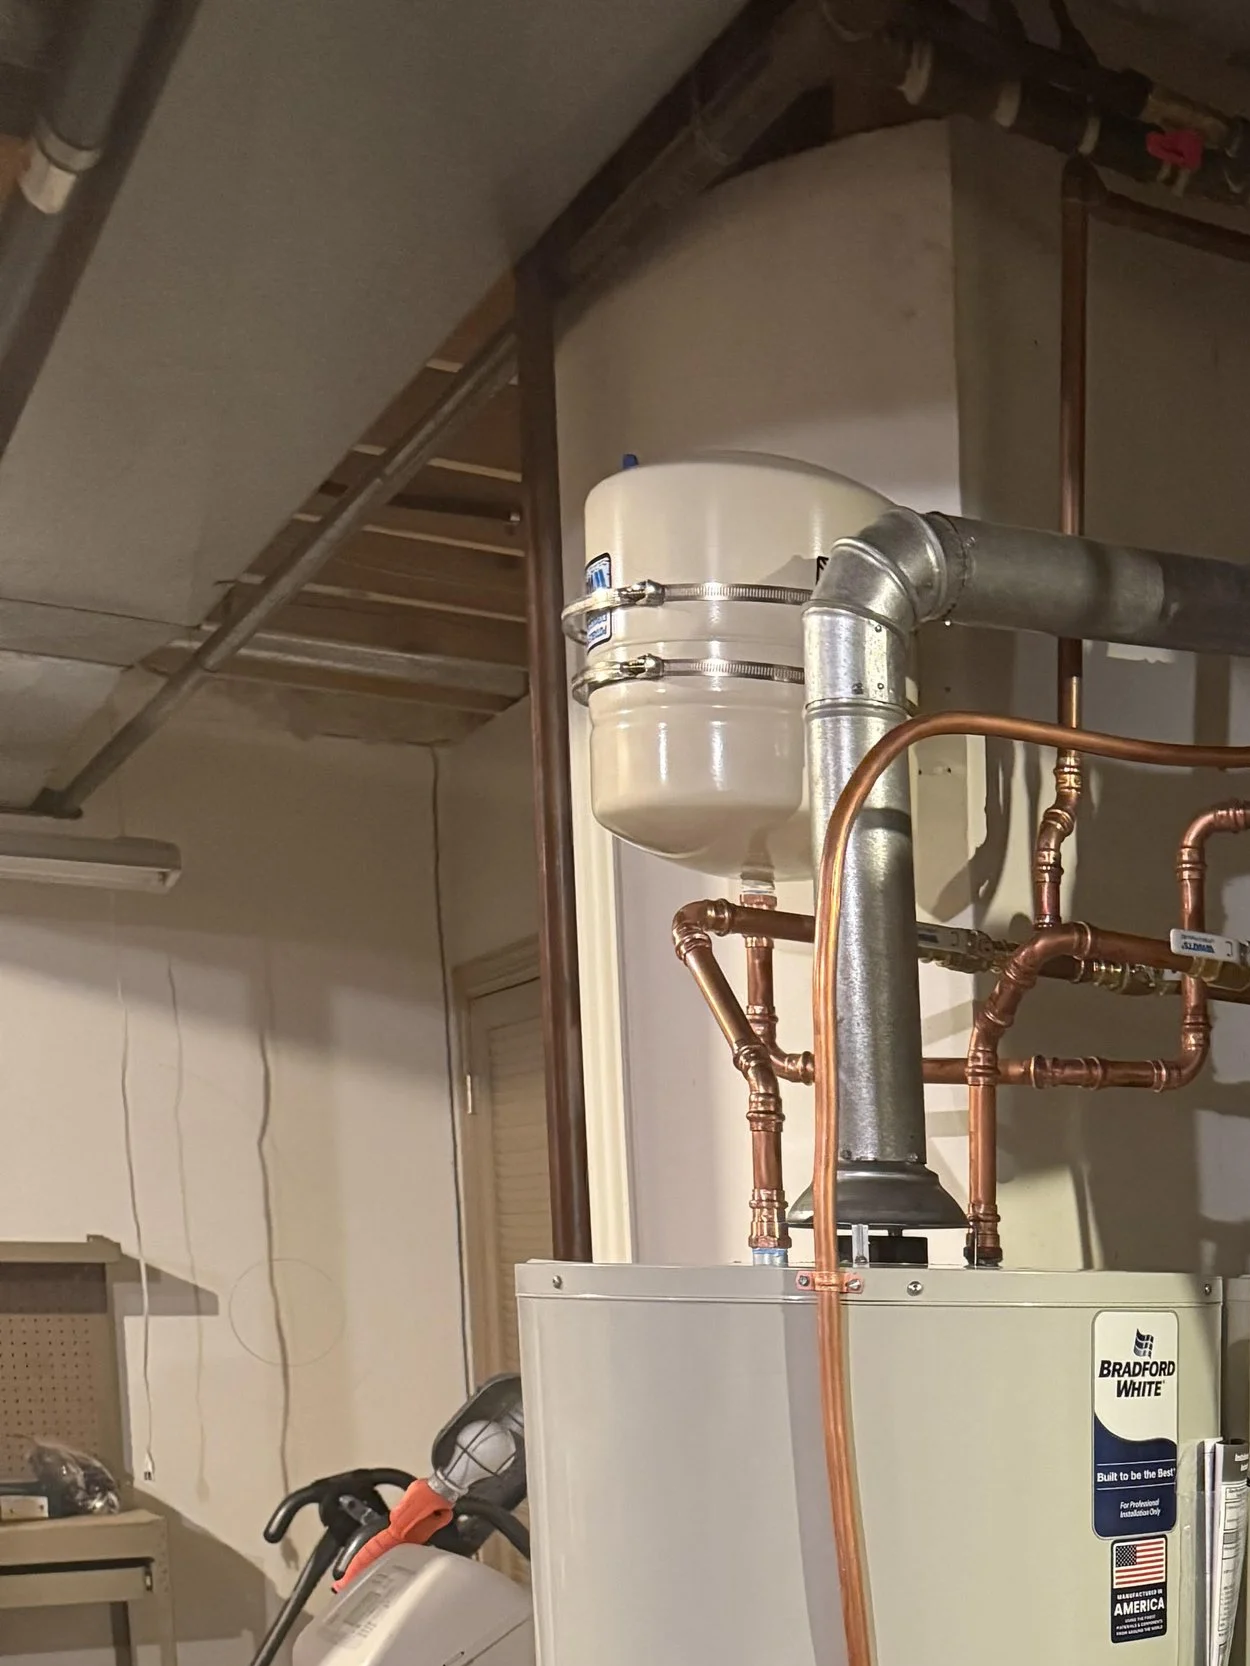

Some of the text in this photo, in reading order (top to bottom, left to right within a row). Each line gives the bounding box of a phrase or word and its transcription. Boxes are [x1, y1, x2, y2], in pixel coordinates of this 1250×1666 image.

[1099, 1360, 1175, 1378] BRADFORD
[1117, 1380, 1163, 1398] WHITE
[1097, 1468, 1173, 1482] Built to be the Best
[1130, 1498, 1160, 1509] Professional
[1120, 1508, 1160, 1518] Installation Only
[1117, 1589, 1156, 1600] MANUFACTURED
[1114, 1597, 1164, 1616] AMERICA
